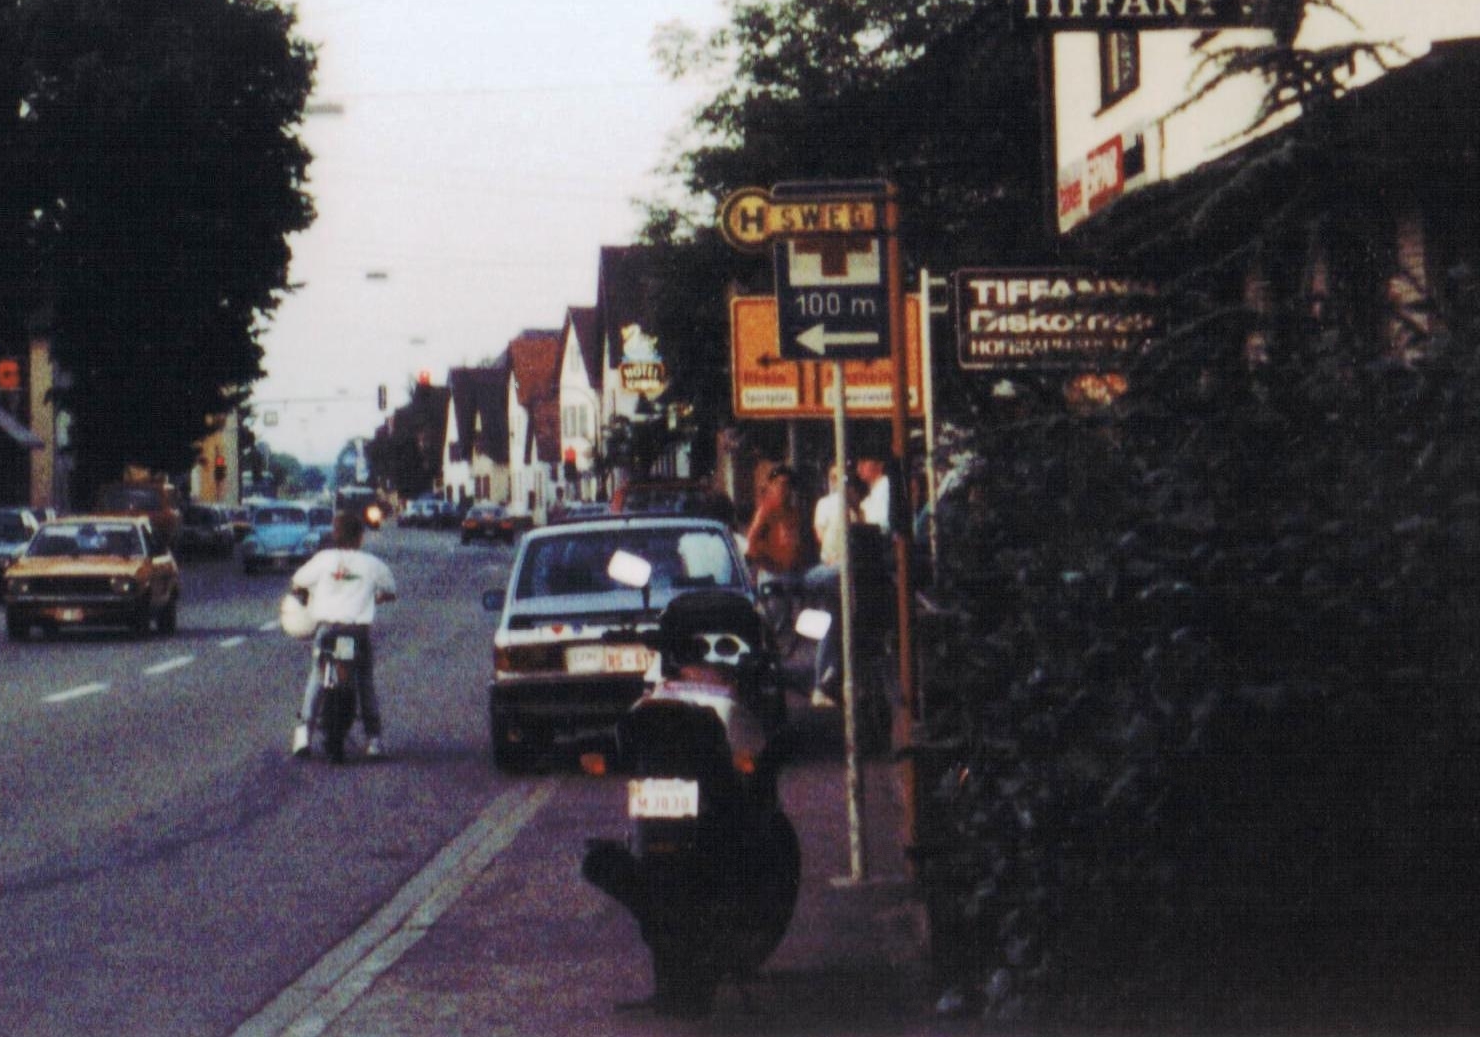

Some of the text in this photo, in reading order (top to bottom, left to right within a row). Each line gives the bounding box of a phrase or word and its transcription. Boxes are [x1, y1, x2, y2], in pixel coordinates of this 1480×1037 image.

[738, 204, 866, 233] H SWEG
[795, 292, 876, 316] 100 m
[623, 364, 659, 380] HOTEL
